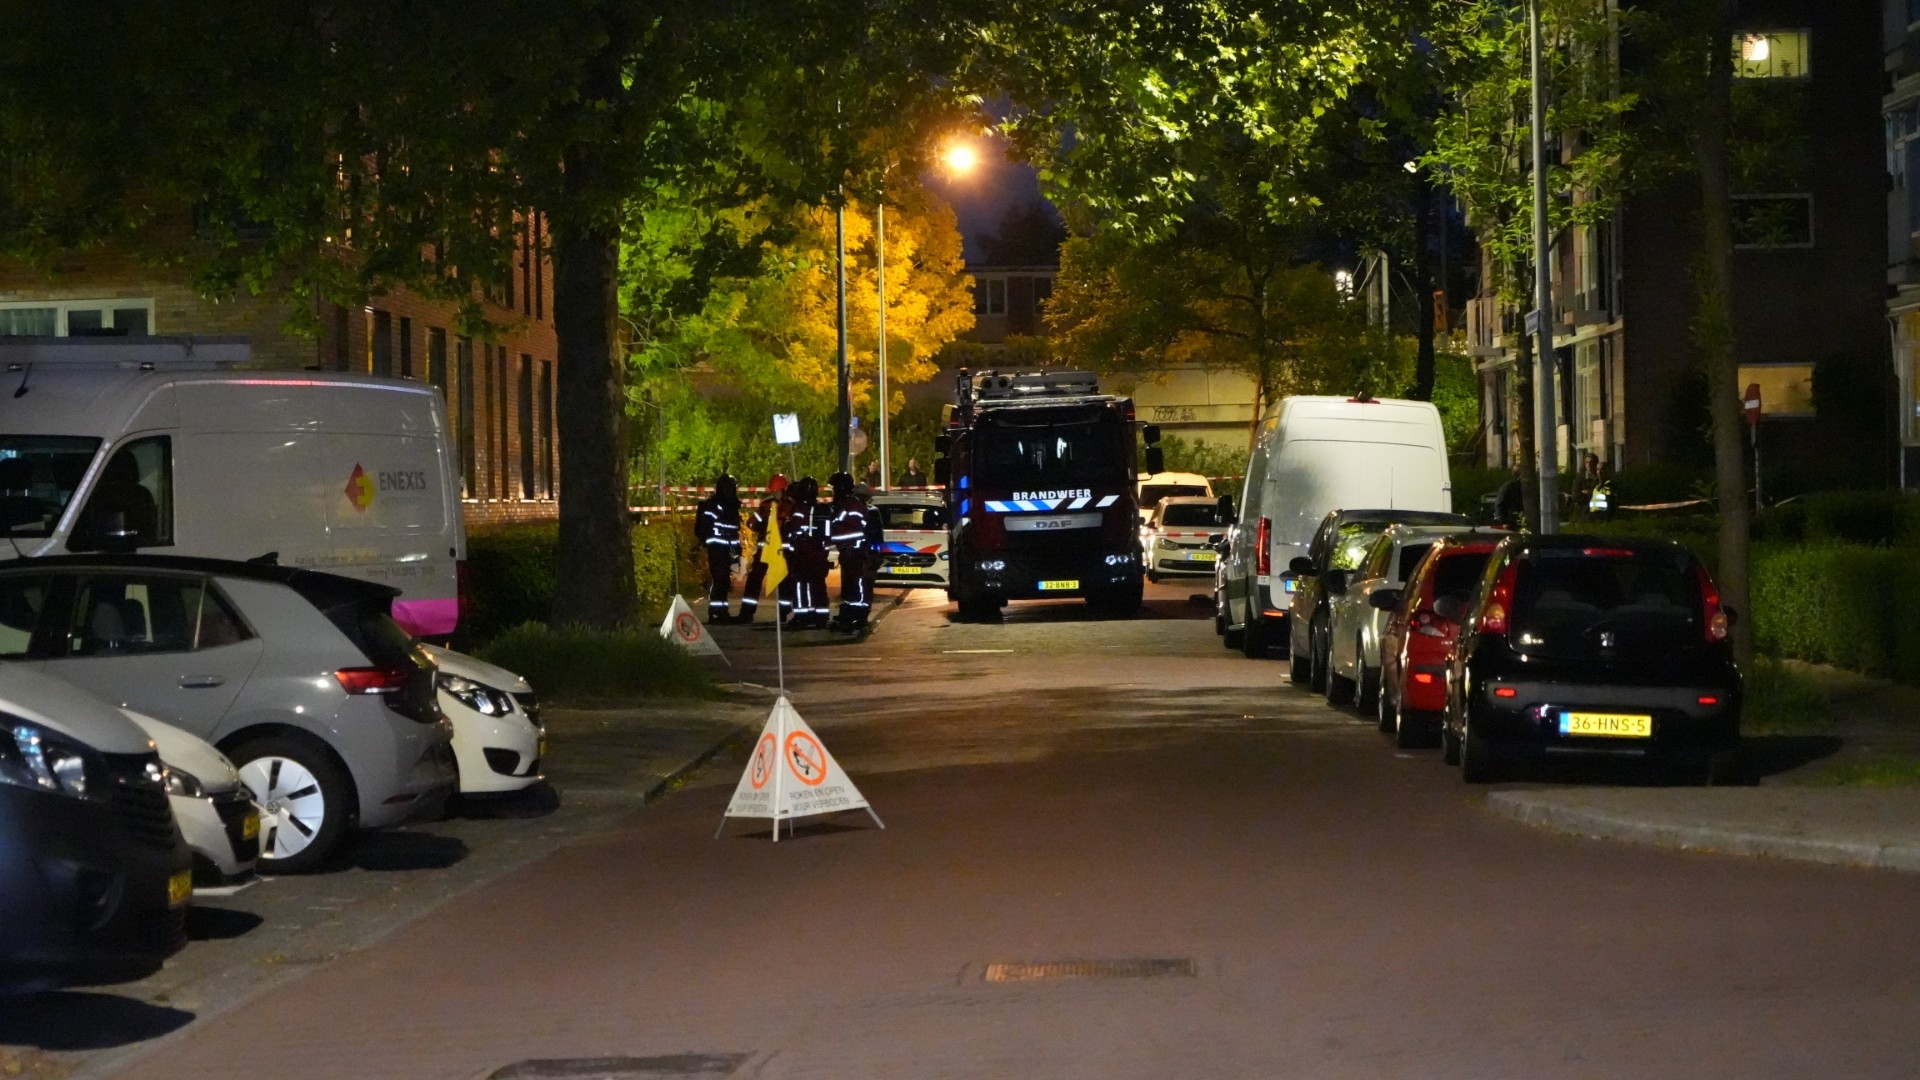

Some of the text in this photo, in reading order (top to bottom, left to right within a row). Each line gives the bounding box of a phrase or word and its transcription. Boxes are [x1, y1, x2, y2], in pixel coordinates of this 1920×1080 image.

[378, 471, 426, 491] ENEXIS
[1012, 488, 1092, 501] BRANDWEER
[1035, 520, 1072, 529] DAF
[1571, 716, 1646, 733] 36-HNS-5
[789, 785, 845, 800] ROKEN EN OPEN
